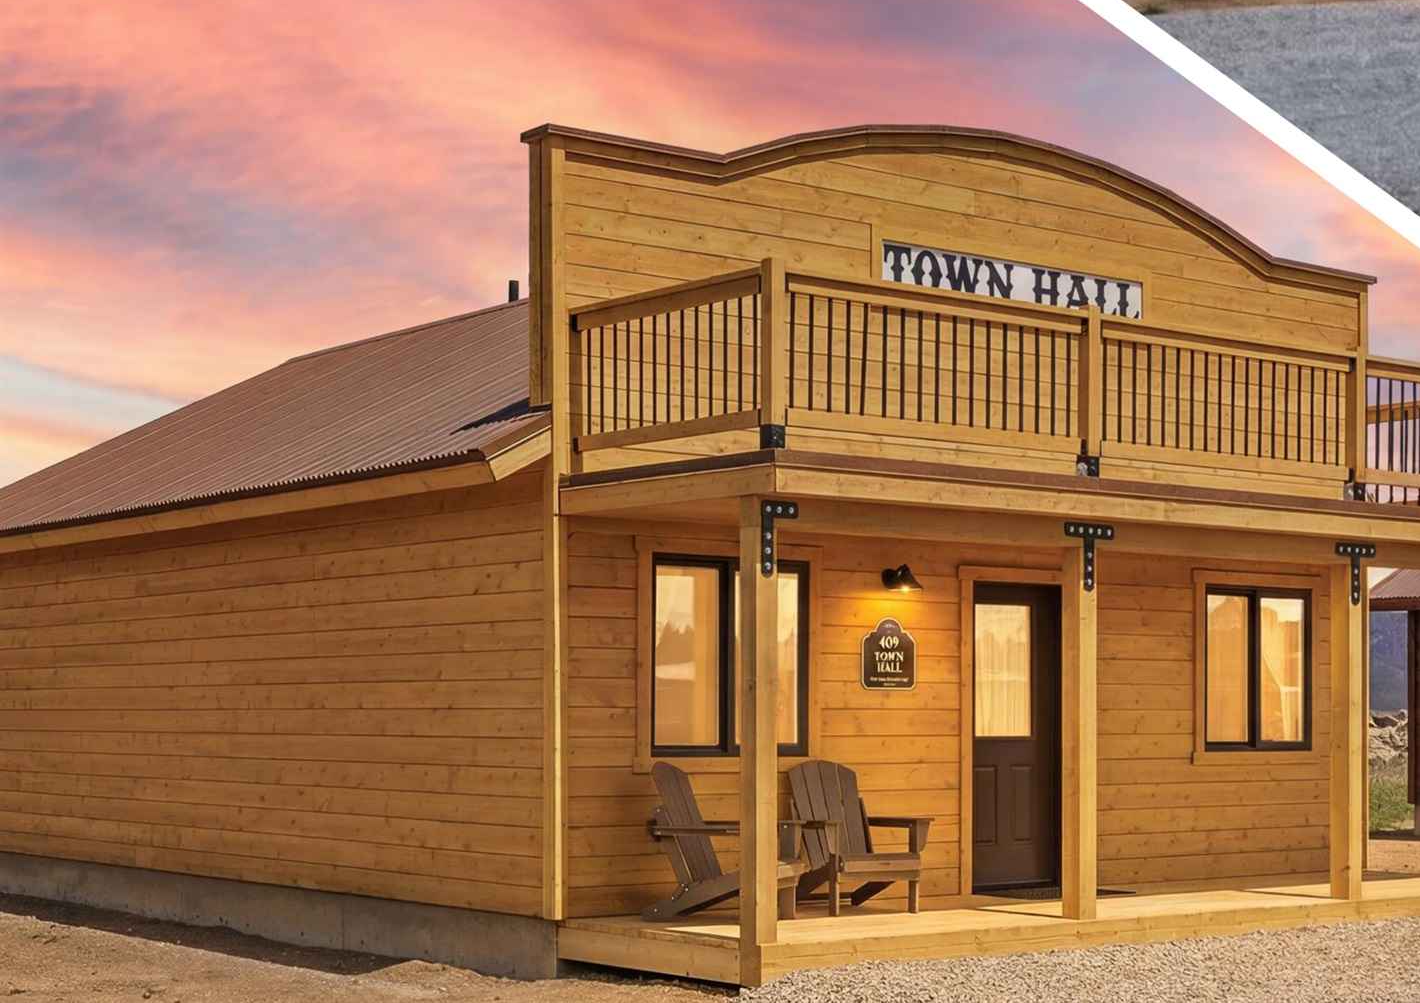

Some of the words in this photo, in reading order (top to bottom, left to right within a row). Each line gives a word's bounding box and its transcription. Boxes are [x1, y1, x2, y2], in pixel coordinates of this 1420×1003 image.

[883, 244, 1014, 300] TOWN
[1031, 268, 1140, 318] HALL
[879, 636, 900, 649] 409
[874, 651, 904, 662] TOWN
[877, 662, 902, 673] HALL
